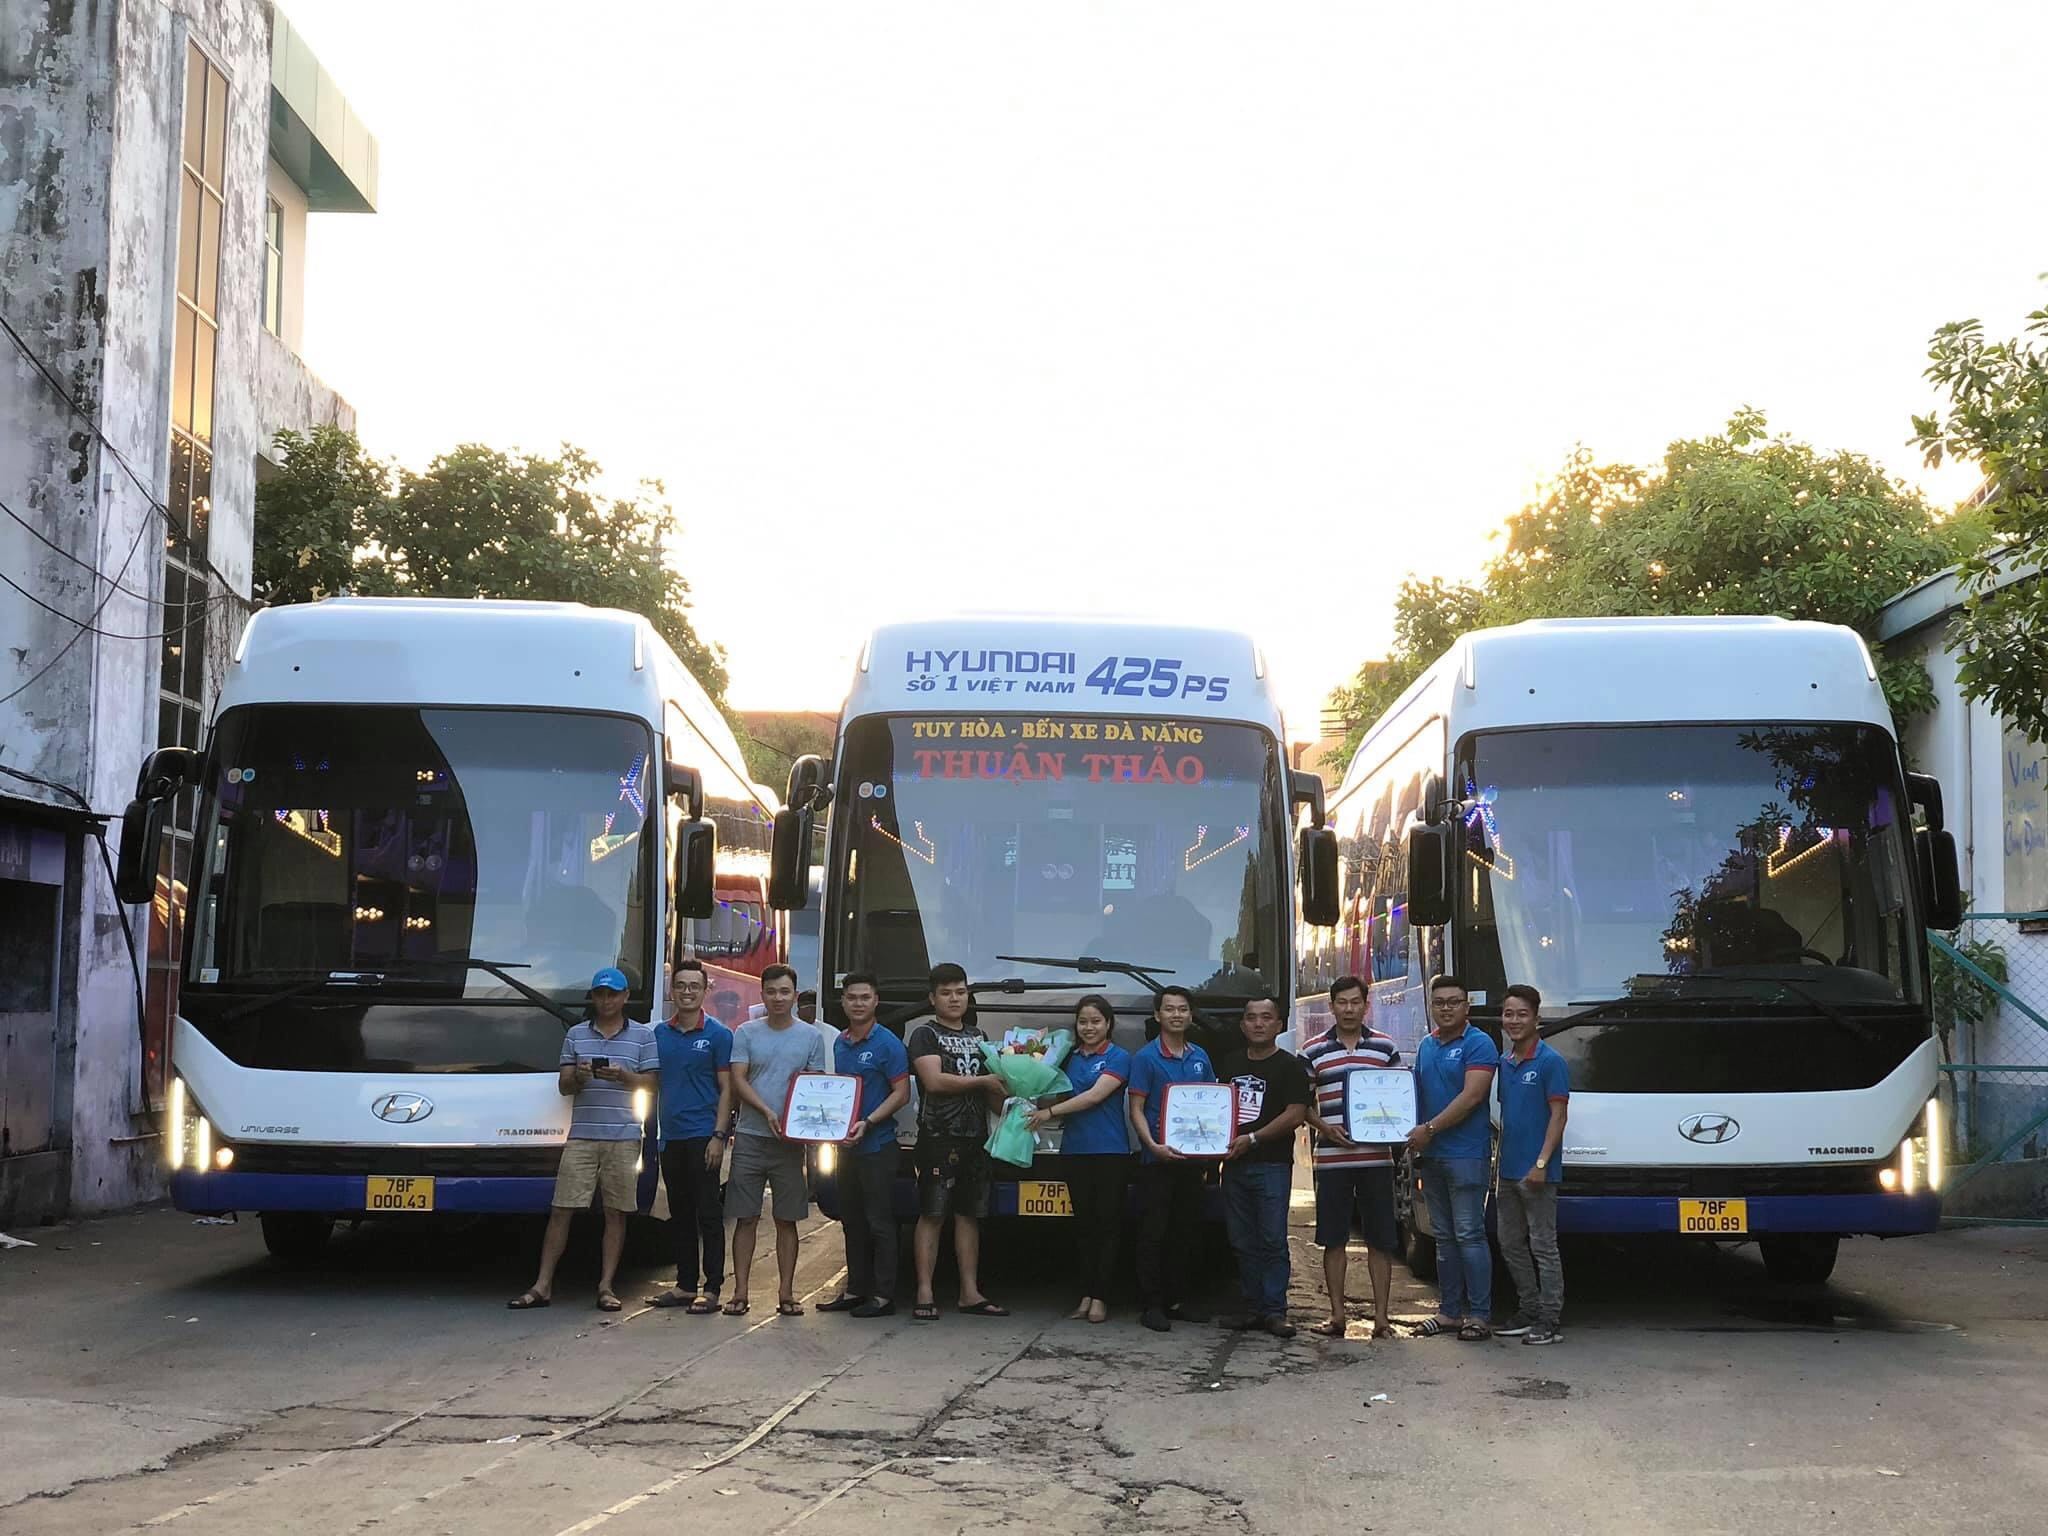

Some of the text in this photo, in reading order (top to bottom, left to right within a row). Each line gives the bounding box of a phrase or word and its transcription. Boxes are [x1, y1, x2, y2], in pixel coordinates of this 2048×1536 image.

[906, 650, 1076, 674] HYUNDAI
[945, 675, 958, 691] 1
[967, 677, 1018, 694] VIỆT
[1025, 680, 1076, 693] NAM
[1085, 656, 1230, 702] 425 PS
[912, 721, 955, 738] TUY
[960, 717, 1006, 738] HÒA
[1022, 717, 1065, 739] BẾN
[1070, 723, 1099, 740] XE
[1104, 721, 1136, 741] ĐÀ
[1141, 721, 1204, 744] NẴNG
[913, 742, 1205, 785] THUẬN THẢO
[1240, 1091, 1257, 1105] SA
[386, 1178, 416, 1193] 78F
[1038, 1184, 1065, 1198] 78F
[373, 1194, 426, 1209] 000.43
[1698, 1200, 1727, 1215] 78F
[1687, 1216, 1740, 1231] 000.89
